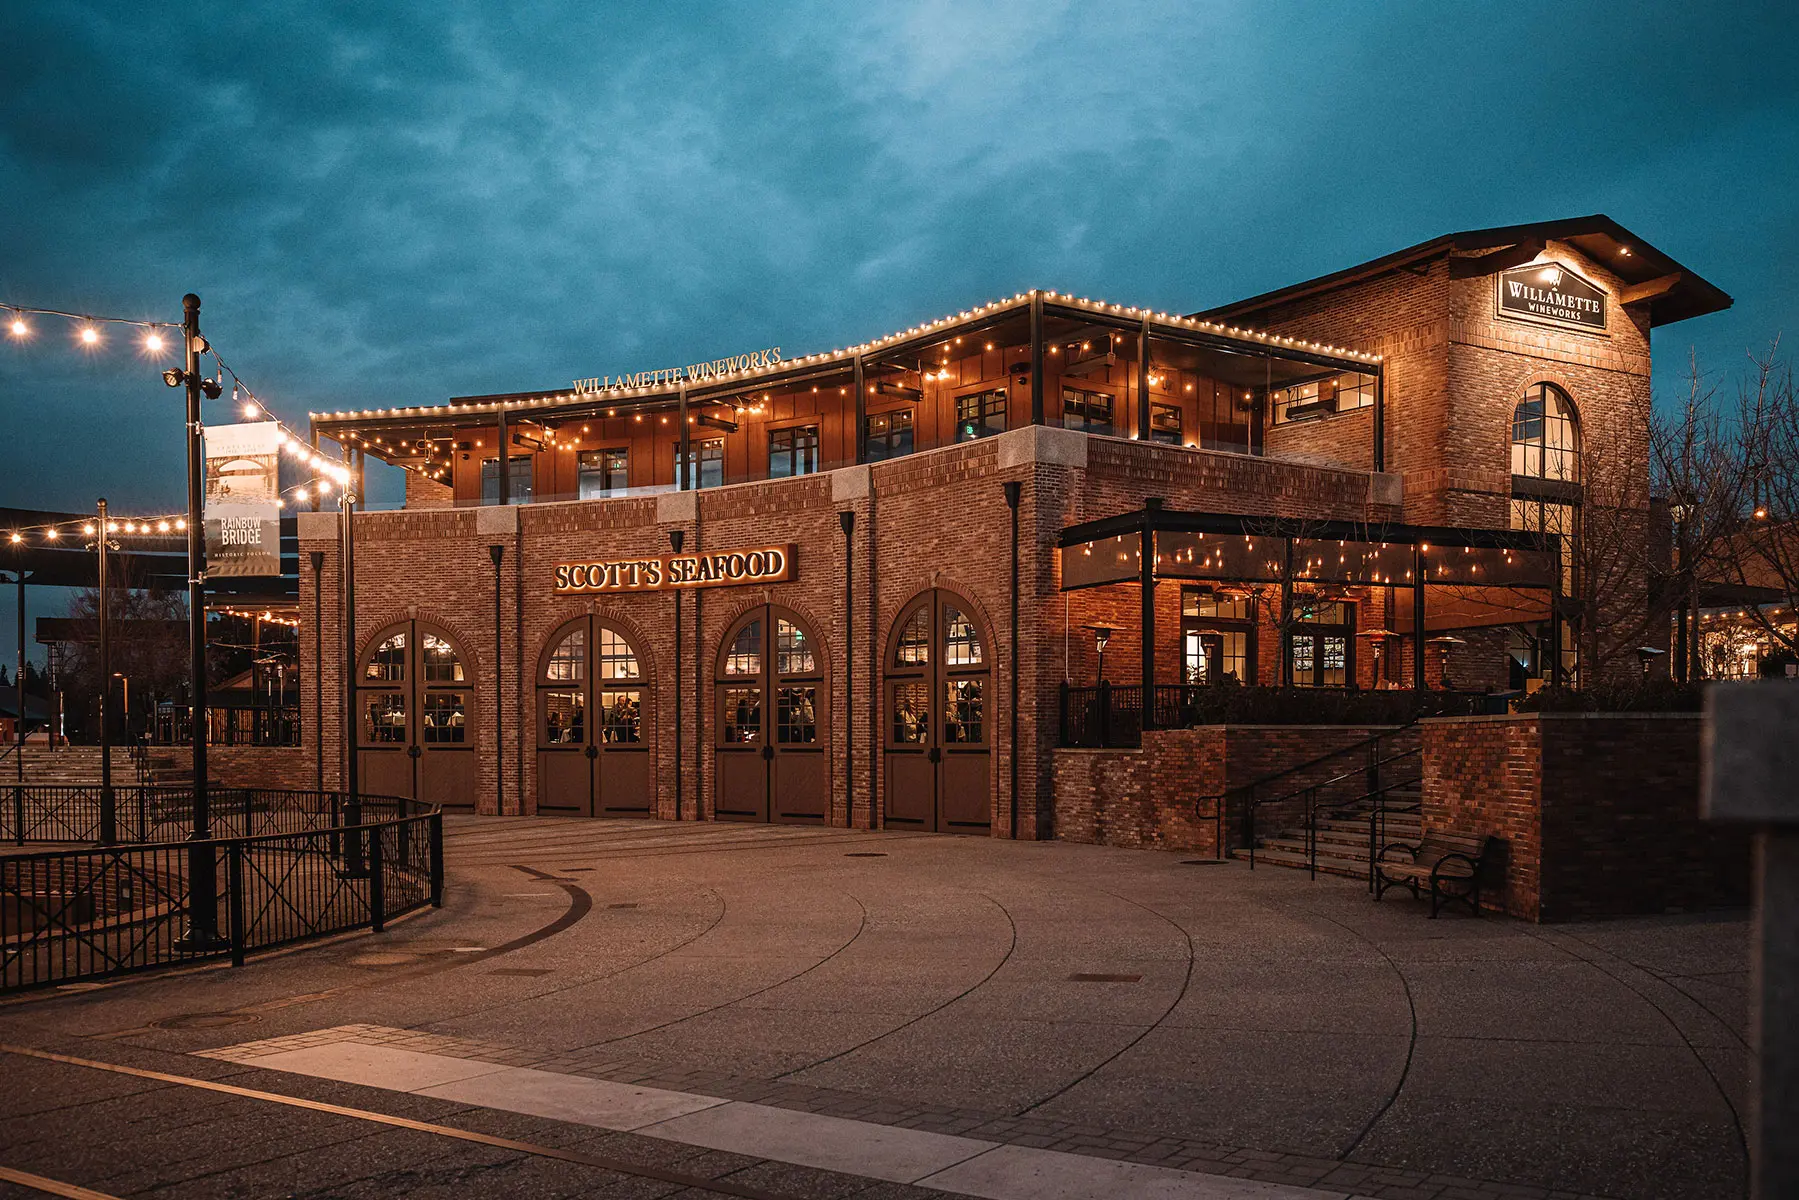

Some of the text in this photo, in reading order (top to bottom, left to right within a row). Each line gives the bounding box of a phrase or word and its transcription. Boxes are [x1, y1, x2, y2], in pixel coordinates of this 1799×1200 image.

[1508, 280, 1600, 314] WILLAMETTE
[1528, 302, 1581, 320] WINEWORKS
[572, 346, 782, 395] WILLAMETTE WINEWORKS
[221, 516, 262, 530] RAINBOW
[221, 528, 262, 546] BRIDGE
[554, 550, 784, 589] SCOTT'S SEAFOOD
